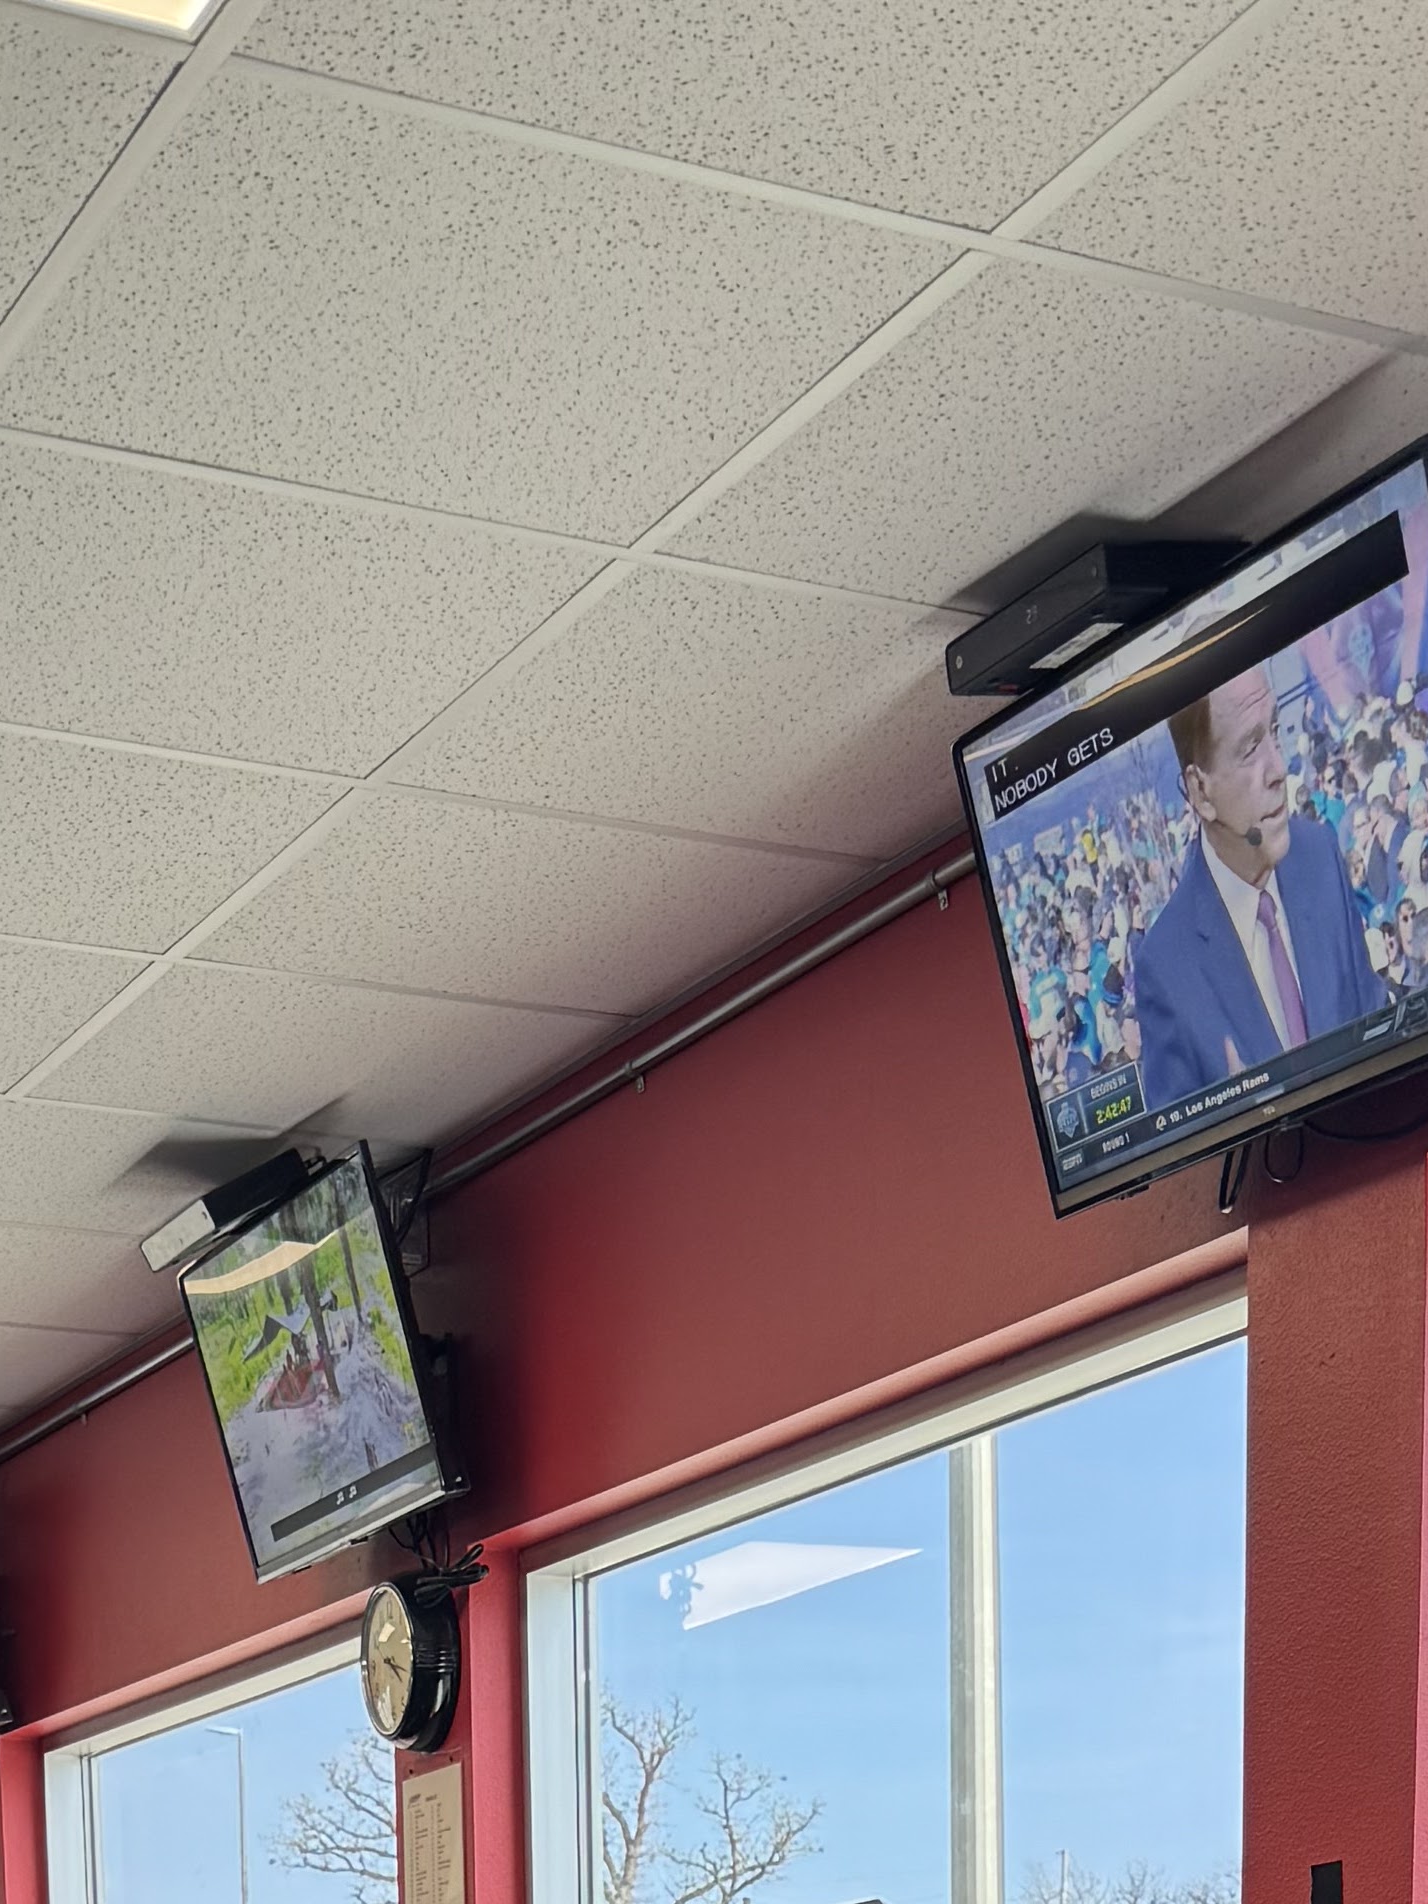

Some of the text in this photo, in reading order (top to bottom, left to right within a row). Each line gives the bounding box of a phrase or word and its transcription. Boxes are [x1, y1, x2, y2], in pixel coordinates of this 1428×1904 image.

[1067, 727, 1114, 767] GETS
[994, 757, 1058, 812] NOBODY
[1185, 1101, 1204, 1117] Los
[1205, 1084, 1242, 1109] Angeles
[1242, 1072, 1270, 1092] Rams
